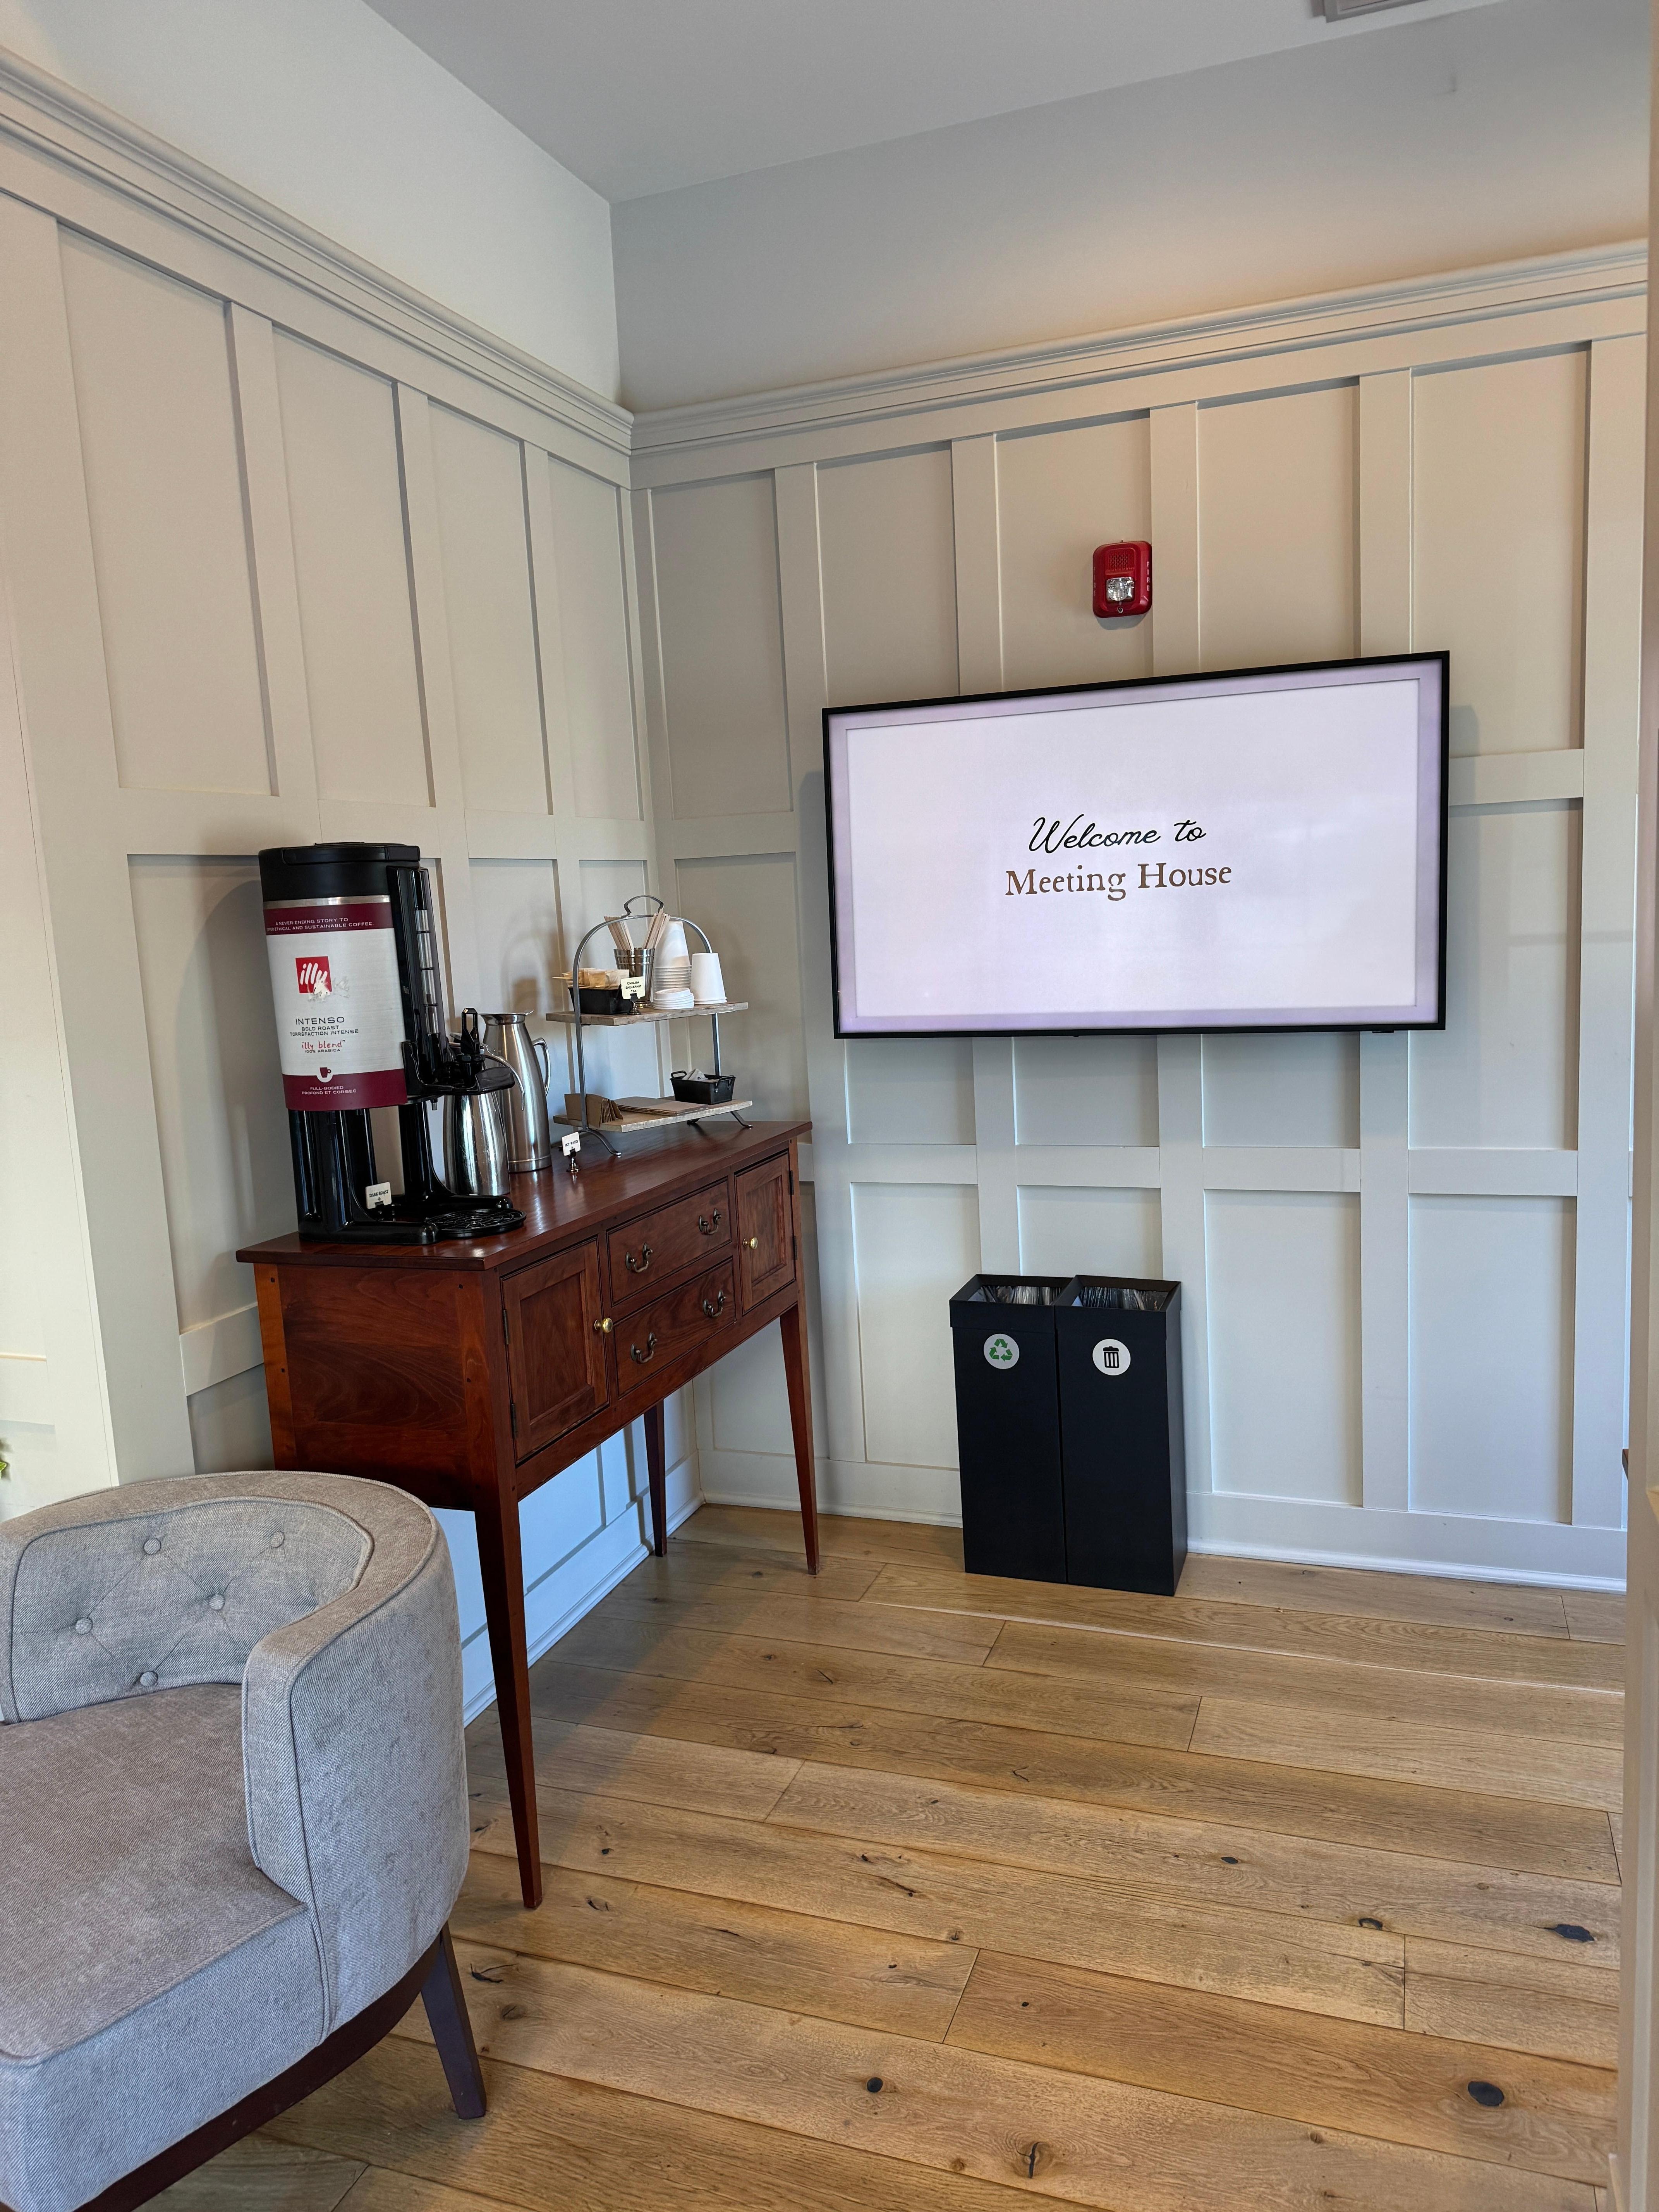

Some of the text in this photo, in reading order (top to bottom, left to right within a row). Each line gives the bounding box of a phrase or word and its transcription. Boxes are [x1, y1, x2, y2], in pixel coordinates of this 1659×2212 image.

[1029, 814, 1207, 854] Welcome to
[1005, 862, 1232, 901] Meeting House
[300, 962, 328, 986] illy
[295, 1017, 345, 1025] INTENSO
[302, 1041, 314, 1051] illy
